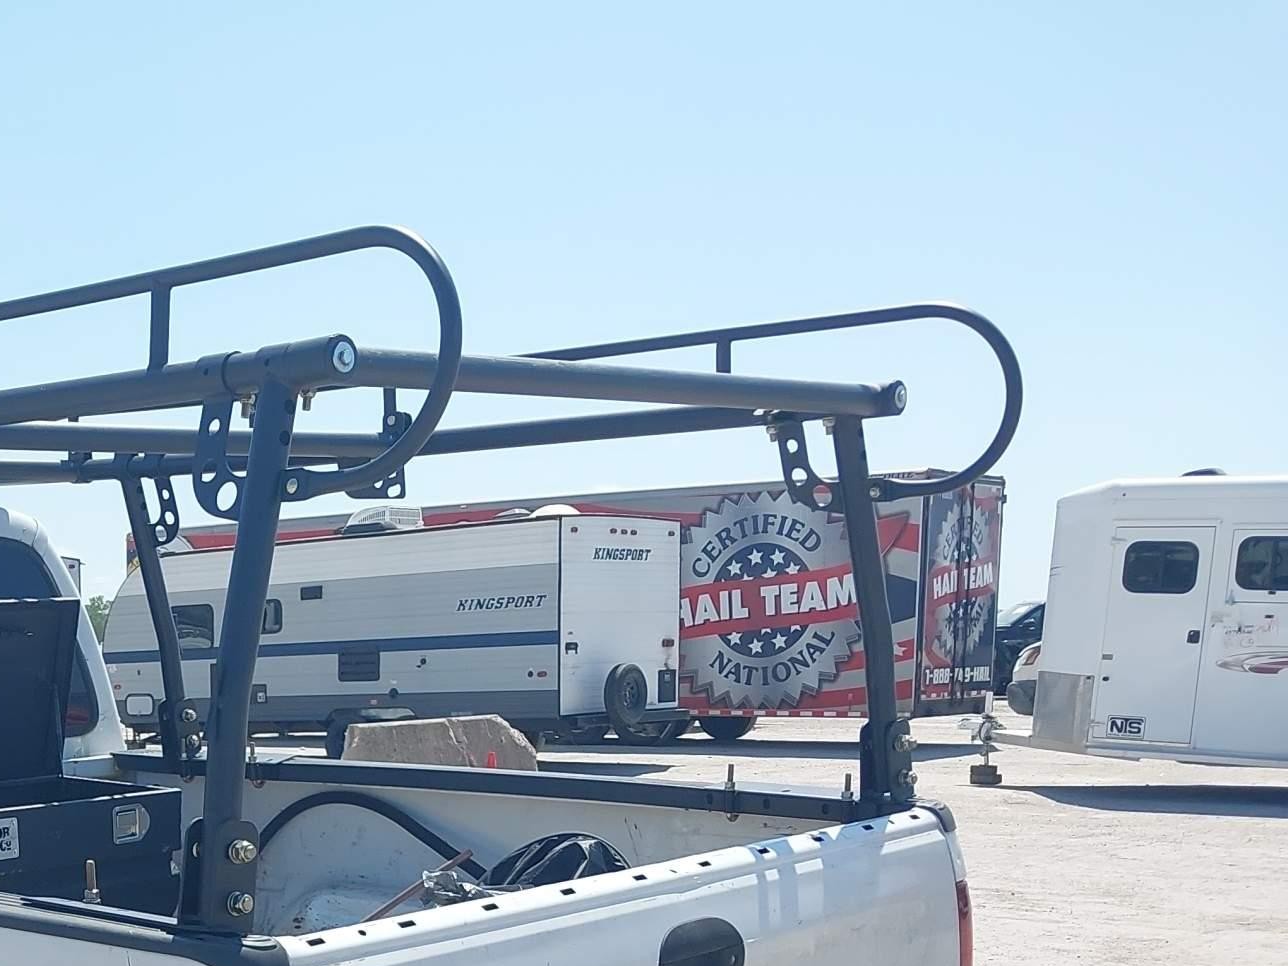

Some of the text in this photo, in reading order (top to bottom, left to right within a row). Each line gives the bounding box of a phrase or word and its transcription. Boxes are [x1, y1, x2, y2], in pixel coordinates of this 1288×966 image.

[593, 547, 651, 561] KINGSPORT
[692, 514, 822, 577] CERTIFIED
[456, 594, 547, 611] KINGSPORT
[760, 573, 857, 616] TEAM
[709, 631, 835, 686] NATIONAL
